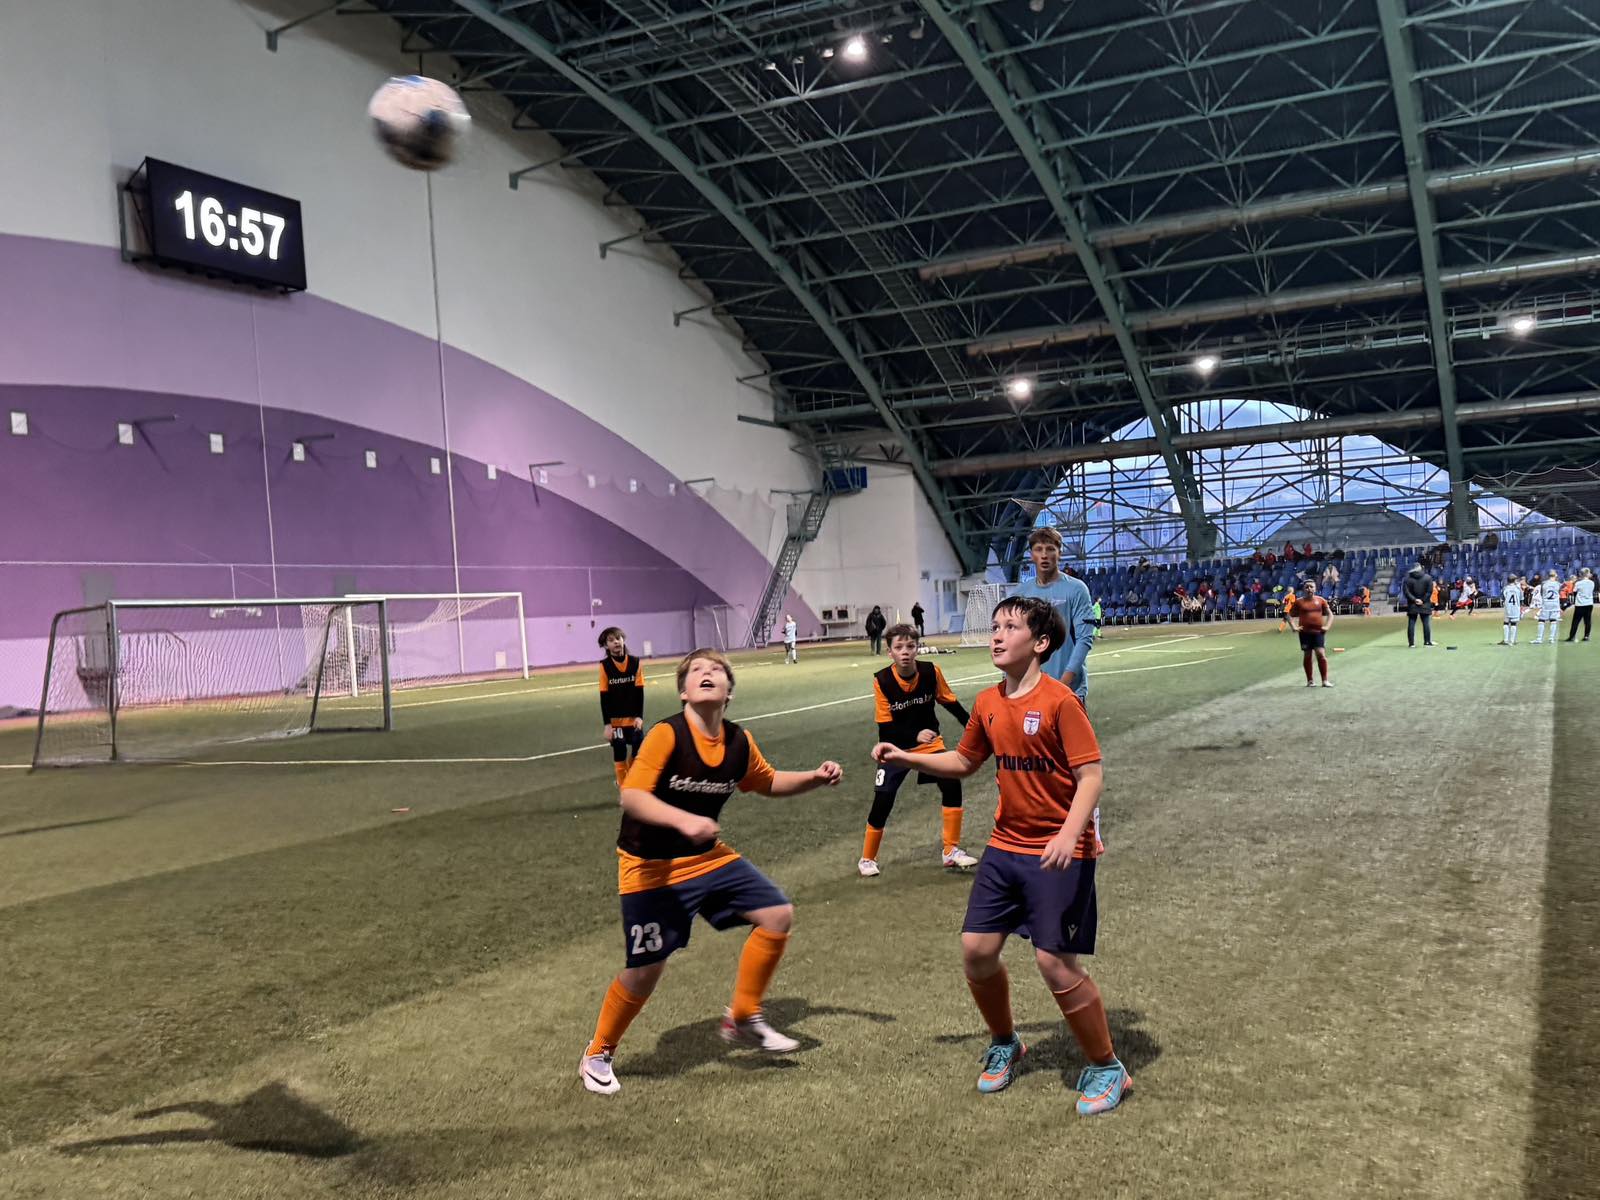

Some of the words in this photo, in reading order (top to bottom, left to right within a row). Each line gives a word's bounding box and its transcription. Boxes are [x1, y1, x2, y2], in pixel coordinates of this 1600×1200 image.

[175, 190, 285, 260] 16:57
[1509, 594, 1516, 605] 4
[1547, 590, 1557, 600] 2
[631, 922, 663, 955] 23
